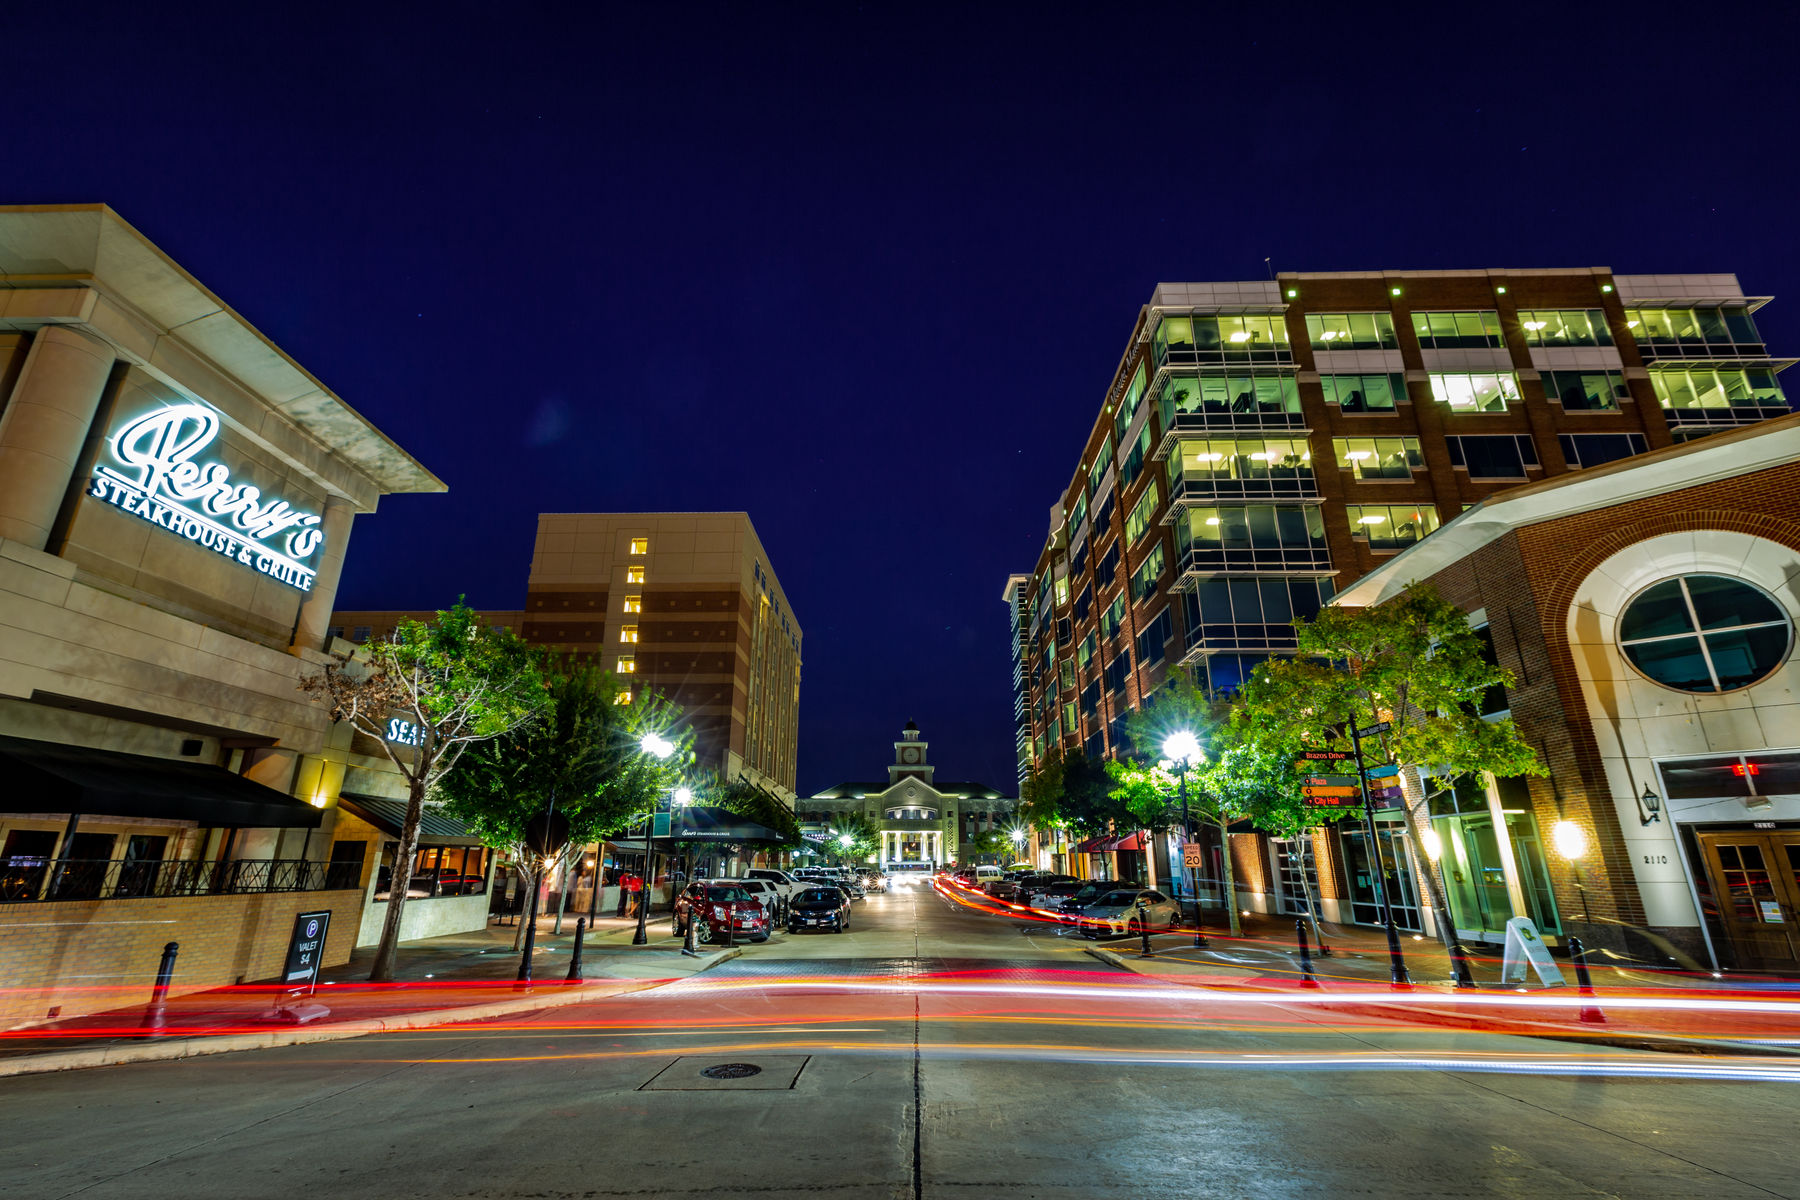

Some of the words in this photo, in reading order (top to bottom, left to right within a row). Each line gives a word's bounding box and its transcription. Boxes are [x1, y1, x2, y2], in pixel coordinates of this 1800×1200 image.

[111, 403, 323, 559] Perry's
[91, 478, 237, 558] STEAKHOUSE
[237, 544, 252, 566] &
[256, 553, 313, 592] GRILLE
[1314, 797, 1326, 806] City
[1327, 797, 1340, 805] Hall
[1186, 856, 1199, 864] 20
[1643, 855, 1667, 865] 2110
[299, 941, 318, 952] VALET
